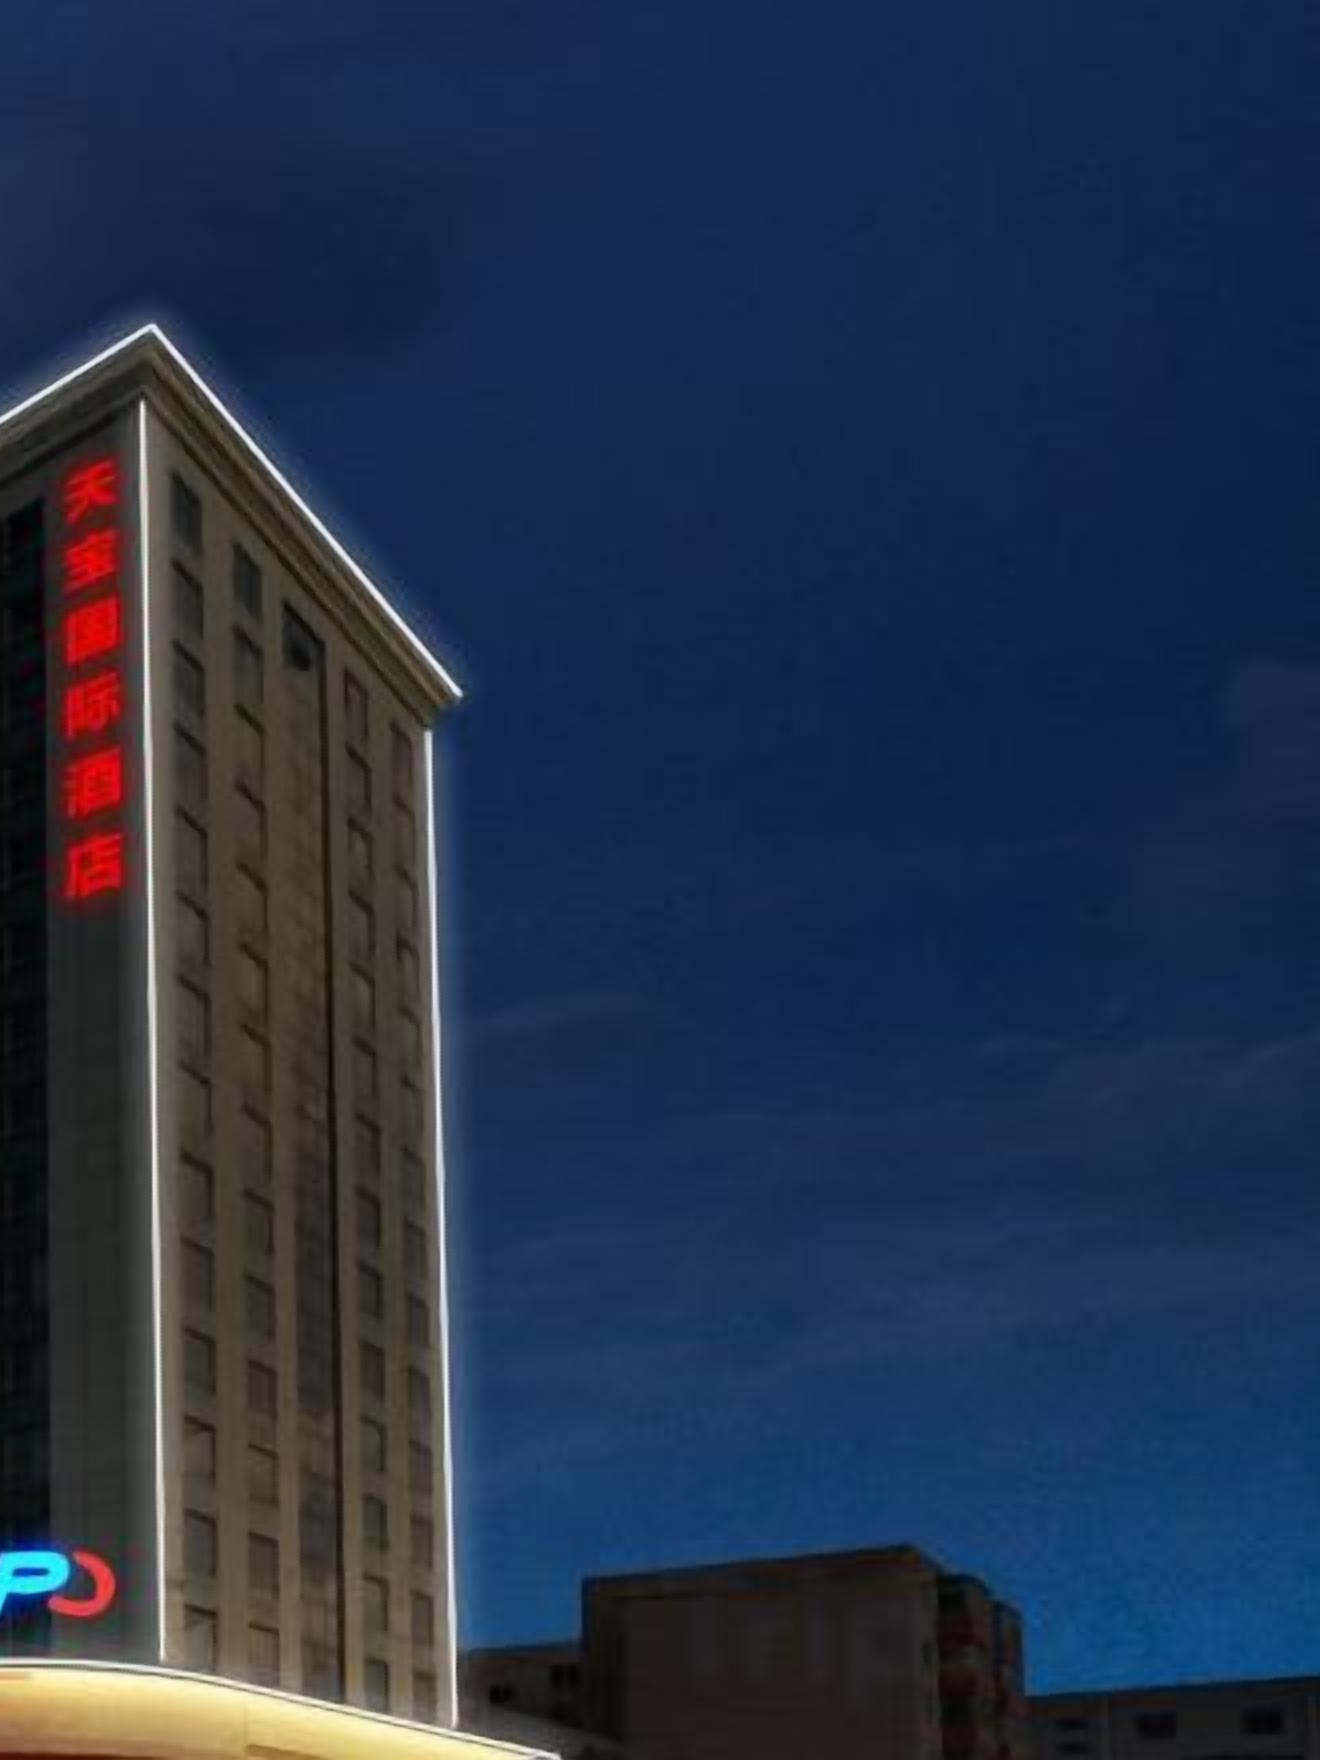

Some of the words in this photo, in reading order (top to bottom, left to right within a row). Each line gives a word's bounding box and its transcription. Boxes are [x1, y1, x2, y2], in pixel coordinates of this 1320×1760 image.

[64, 459, 122, 900] 天宝国际酒店
